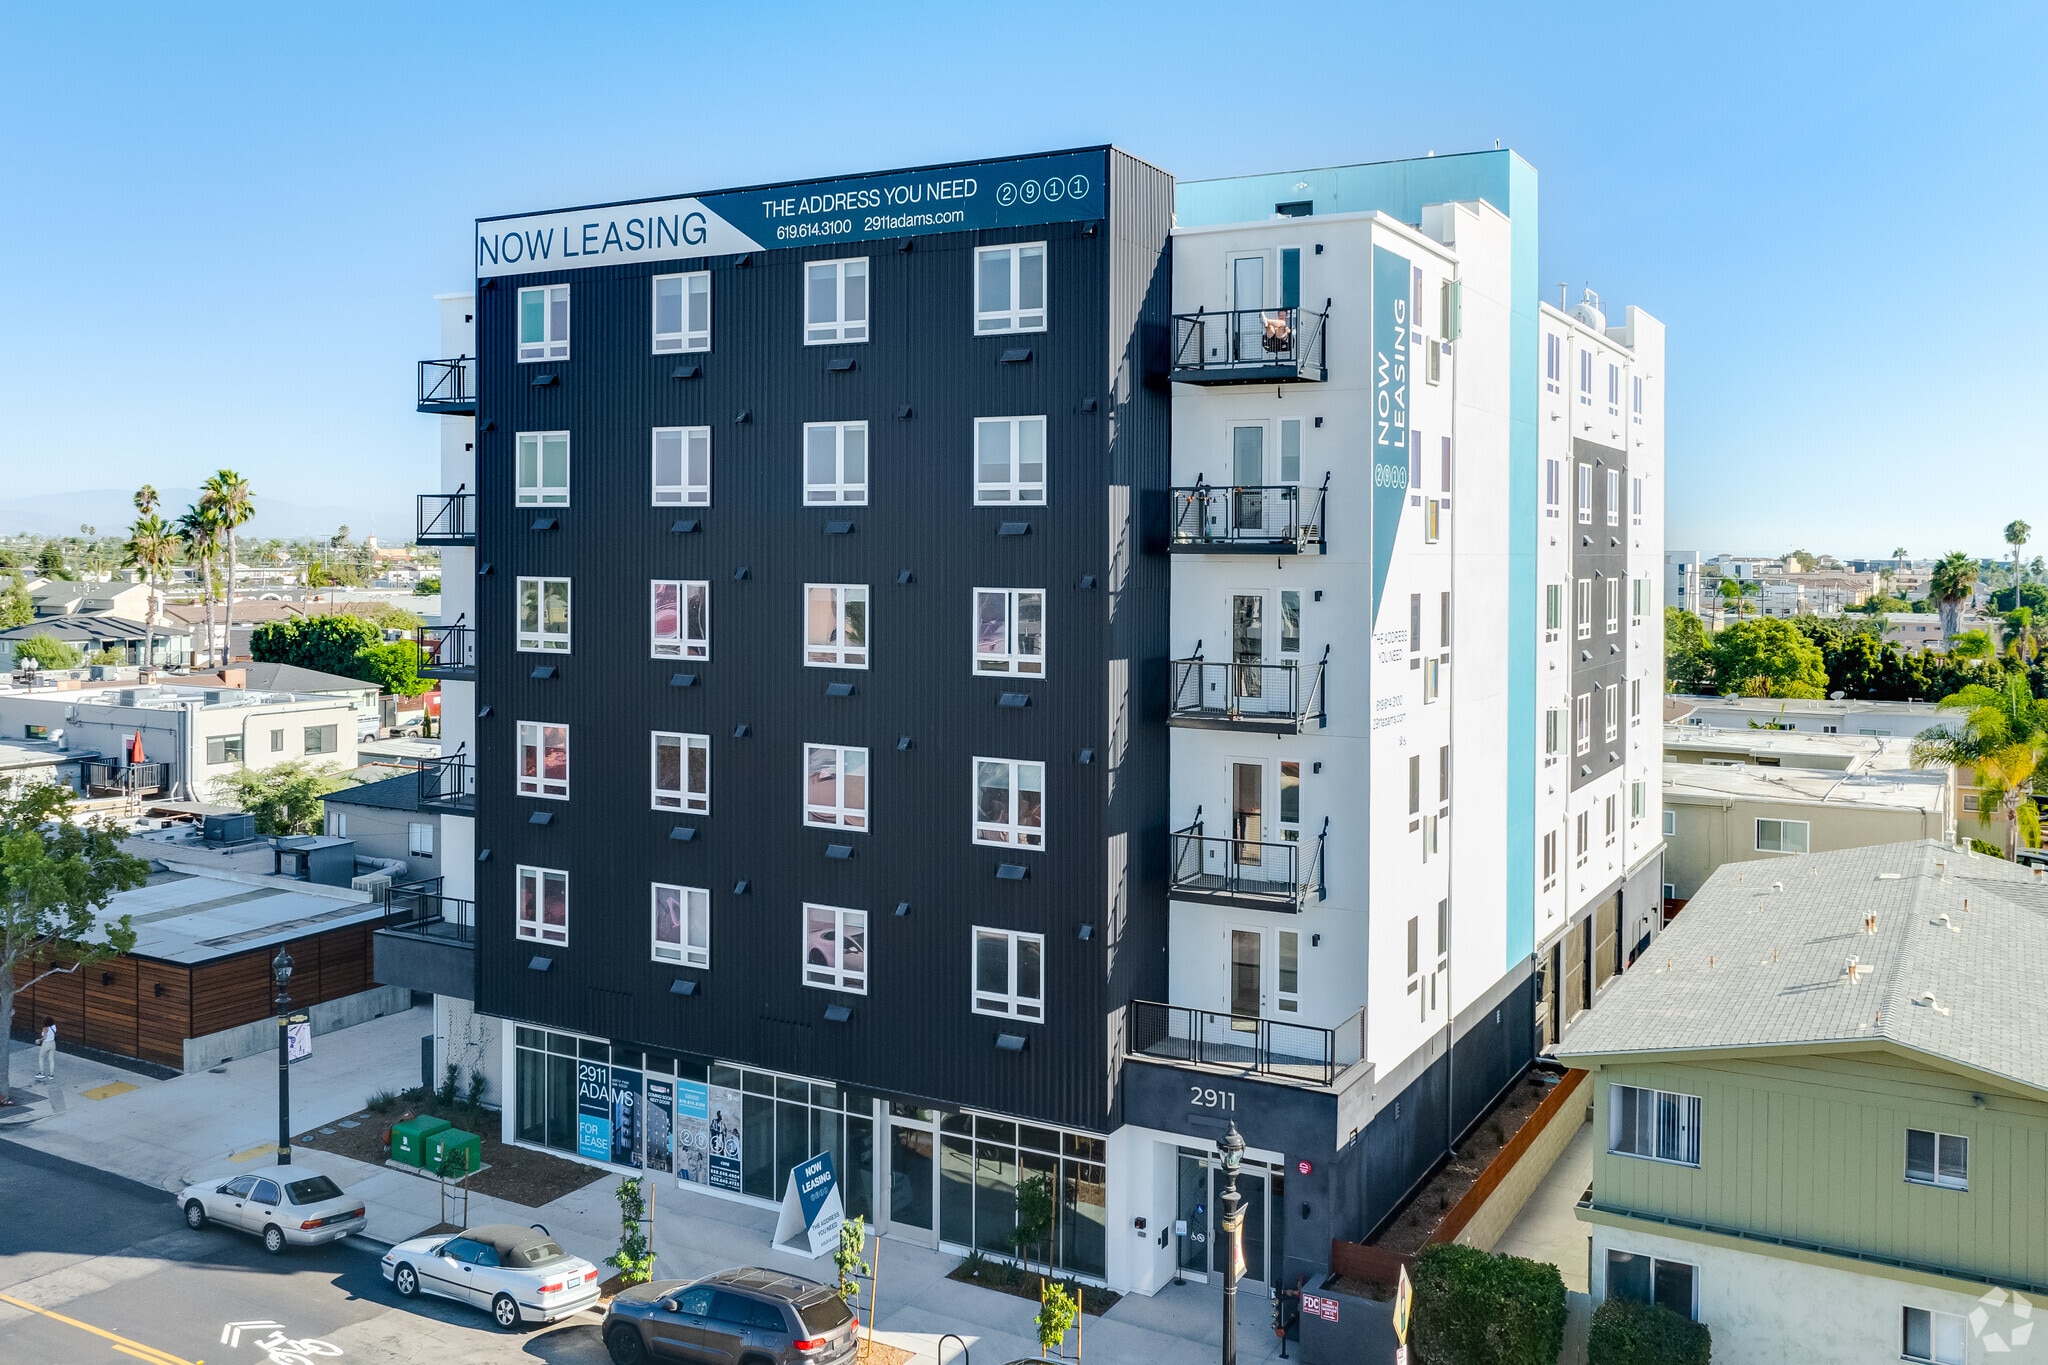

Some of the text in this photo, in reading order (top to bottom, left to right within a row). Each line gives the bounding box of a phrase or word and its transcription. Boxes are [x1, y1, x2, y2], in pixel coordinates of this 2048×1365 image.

[761, 178, 978, 218] THE ADDRESS YOU NEED
[776, 210, 965, 240] 619.614.3100 2911adams.com
[479, 211, 707, 267] NOW LEASING
[1394, 298, 1406, 448] LEASING
[1377, 351, 1390, 446] NOW
[579, 1064, 607, 1084] 2911
[579, 1081, 634, 1107] ADAMS
[1190, 1086, 1235, 1112] 2911
[580, 1121, 598, 1136] FOR
[580, 1133, 609, 1150] LEASE
[804, 1160, 822, 1178] NOW
[801, 1171, 832, 1194] LEASING
[812, 1211, 840, 1231] THE ADDRESS
[817, 1221, 838, 1237] YOU NEED
[1303, 1296, 1319, 1309] FDC
